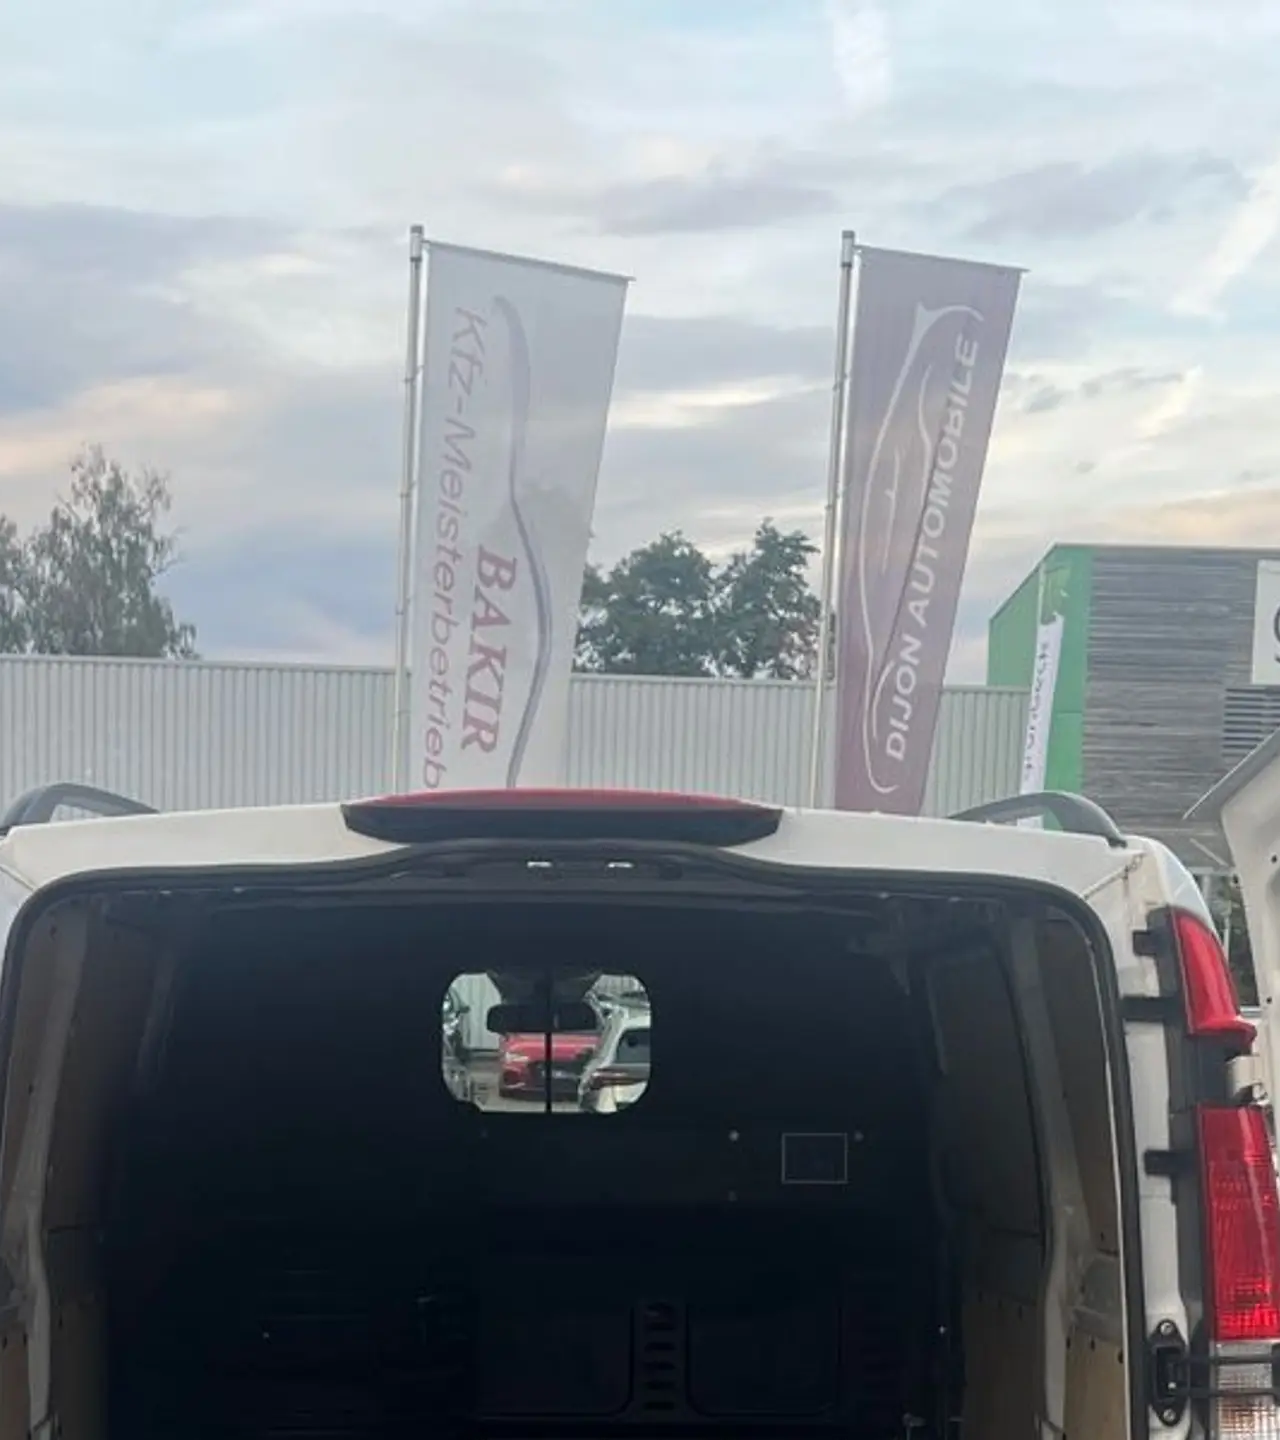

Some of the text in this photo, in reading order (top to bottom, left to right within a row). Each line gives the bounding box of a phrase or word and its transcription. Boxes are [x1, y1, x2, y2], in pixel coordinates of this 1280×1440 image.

[423, 306, 488, 789] Kfz-Meisterbetrieb
[460, 543, 518, 754] BAKIR
[885, 332, 979, 761] DIJON AUTOMOBILE
